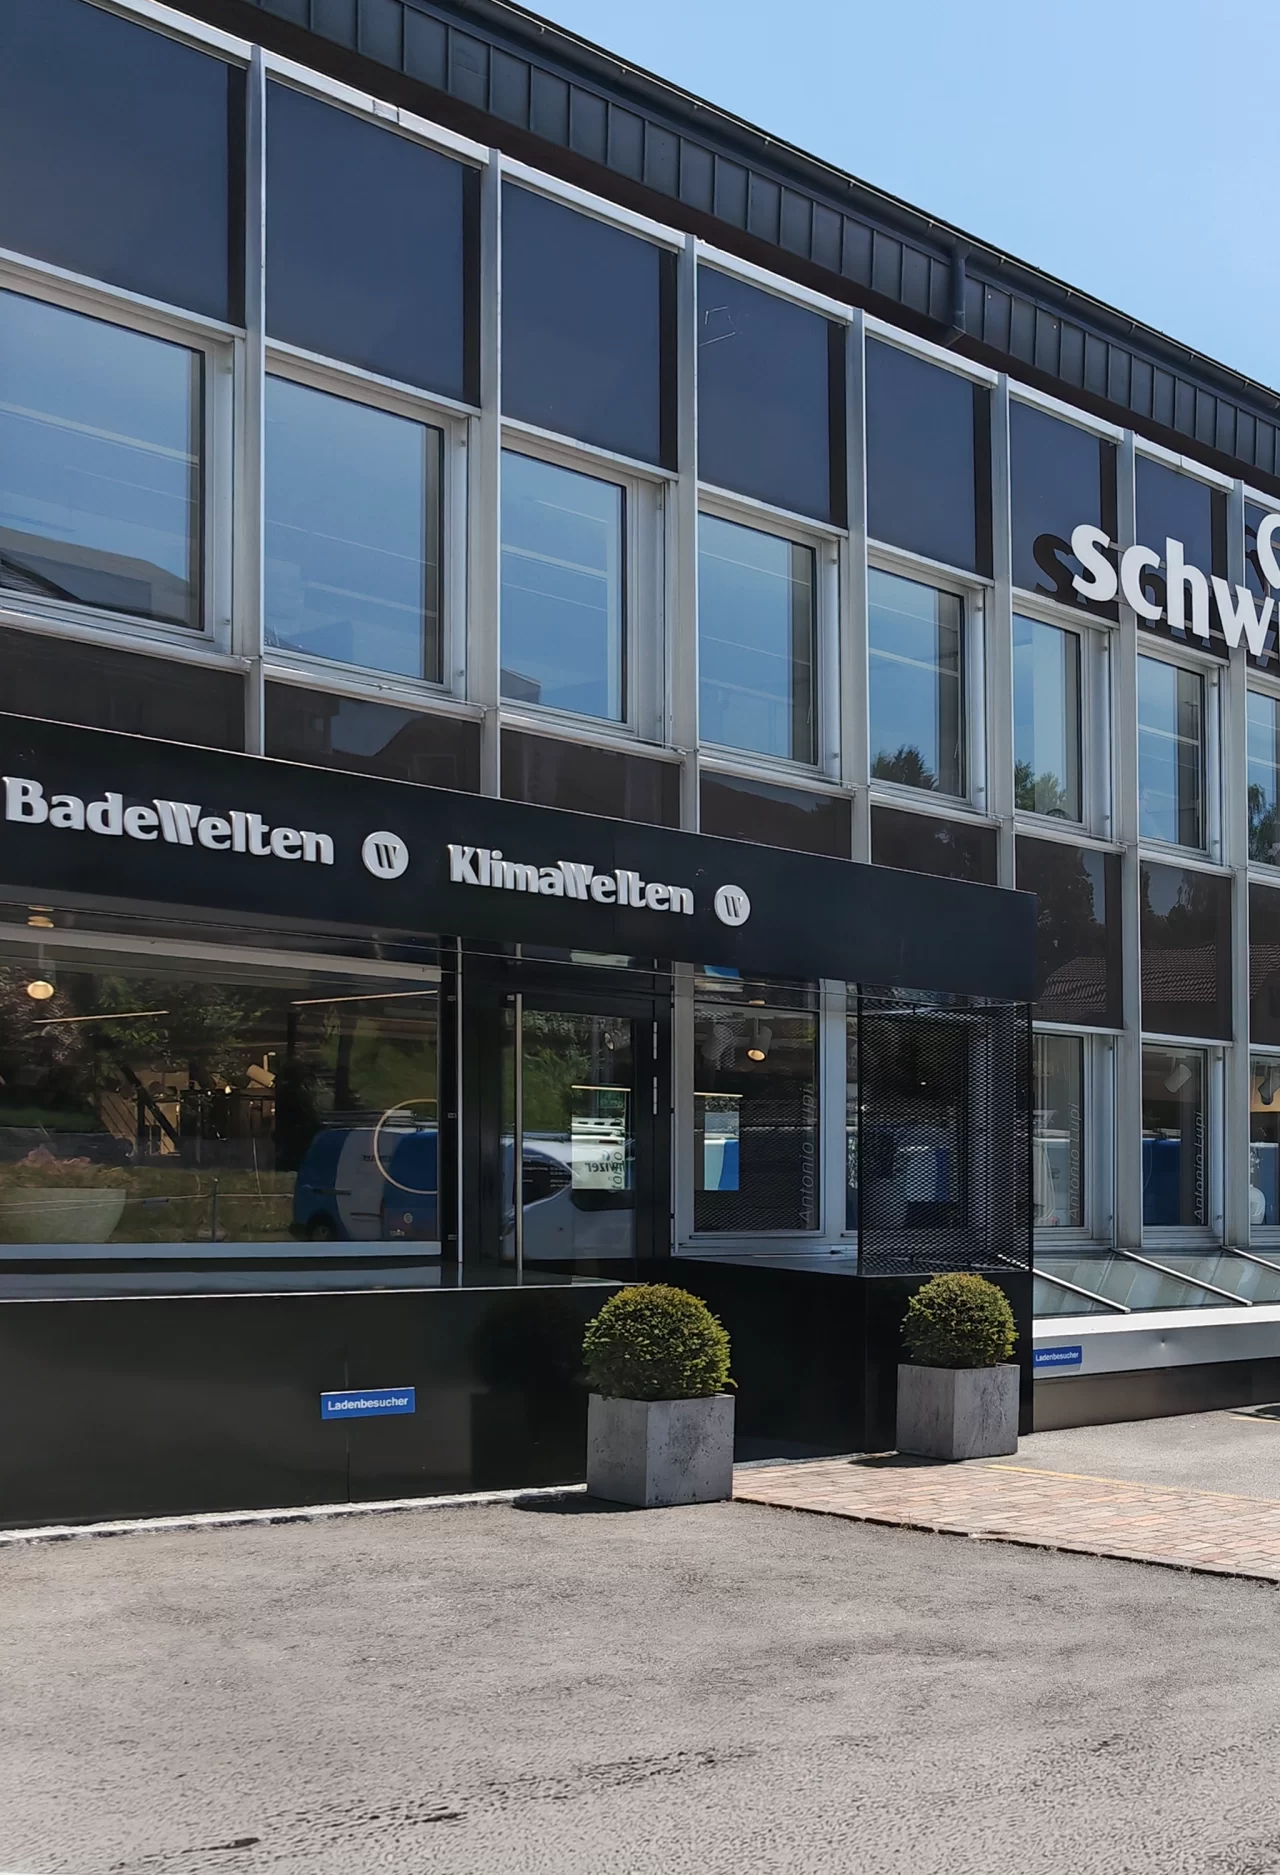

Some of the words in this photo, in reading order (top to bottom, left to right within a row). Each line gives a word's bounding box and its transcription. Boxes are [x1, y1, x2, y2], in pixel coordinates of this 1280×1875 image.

[2, 775, 335, 865] BadeWelten
[447, 843, 695, 915] KlimaWelten
[1035, 1351, 1079, 1362] Ladenbesucher
[327, 1396, 409, 1411] Ladenbesucher
